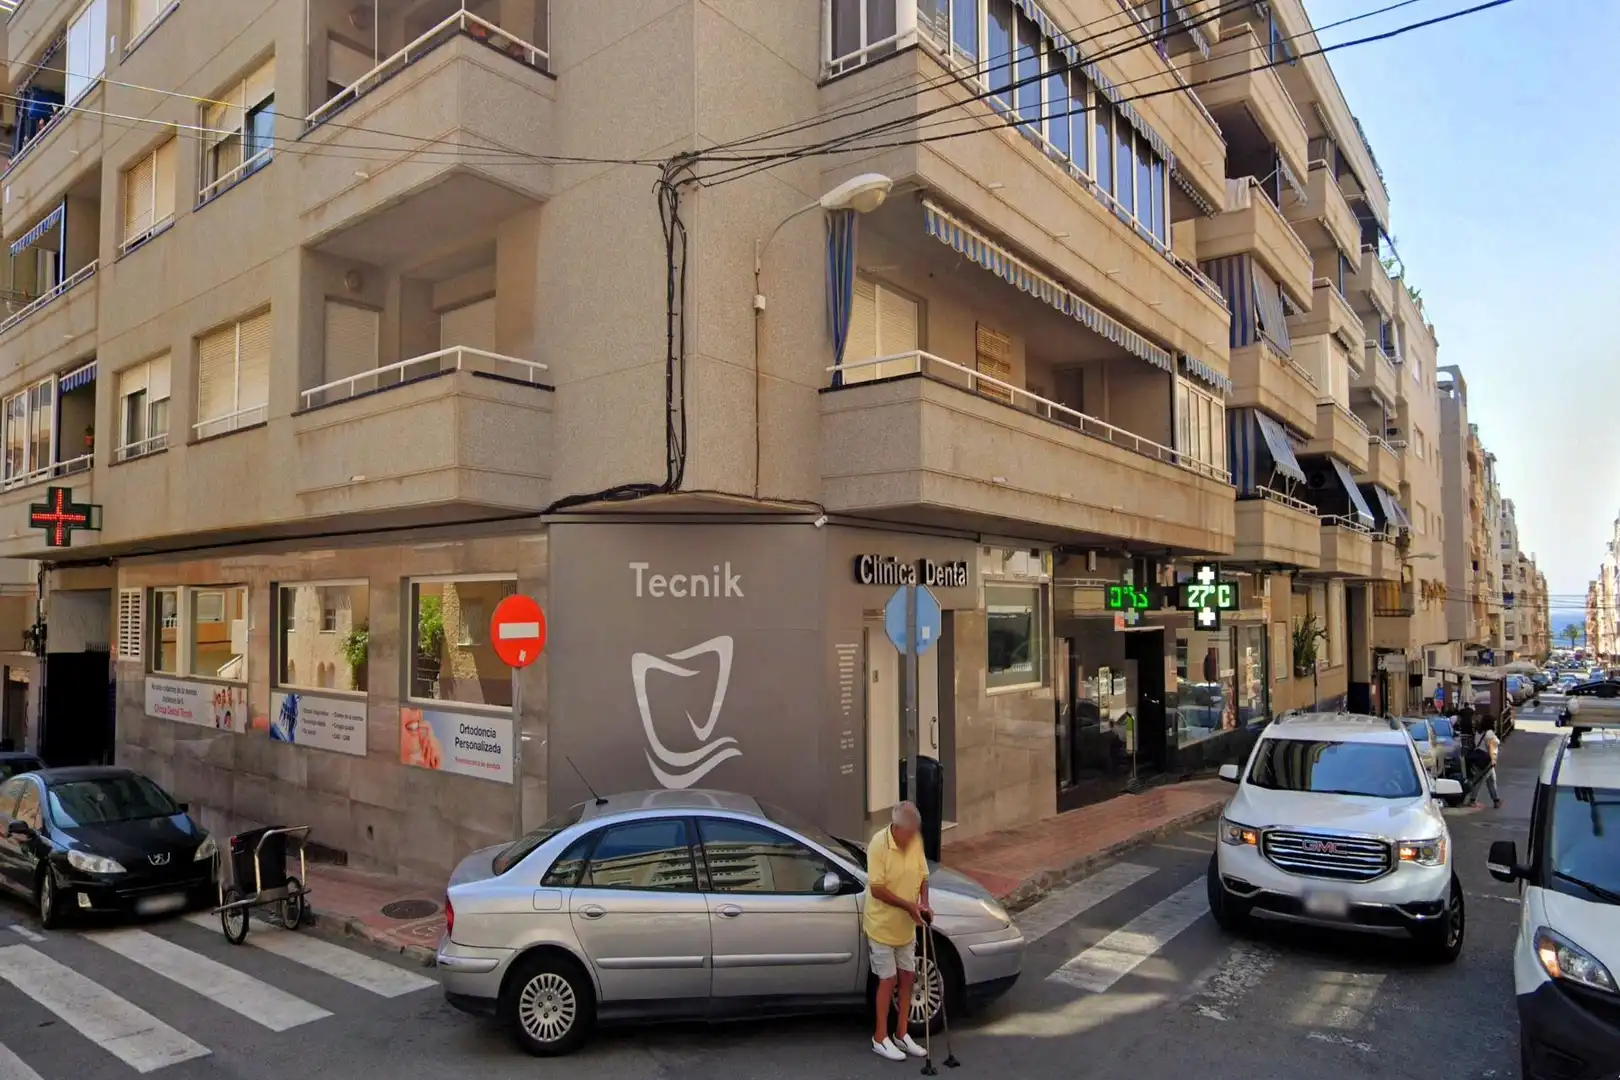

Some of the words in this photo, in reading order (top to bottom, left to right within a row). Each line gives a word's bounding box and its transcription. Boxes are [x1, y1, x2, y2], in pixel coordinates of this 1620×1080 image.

[629, 561, 744, 597] Tecnik
[924, 559, 969, 586] Dental
[459, 723, 497, 739] Ortodoncia
[455, 737, 502, 754] Personalizada
[1302, 839, 1348, 854] GMC
